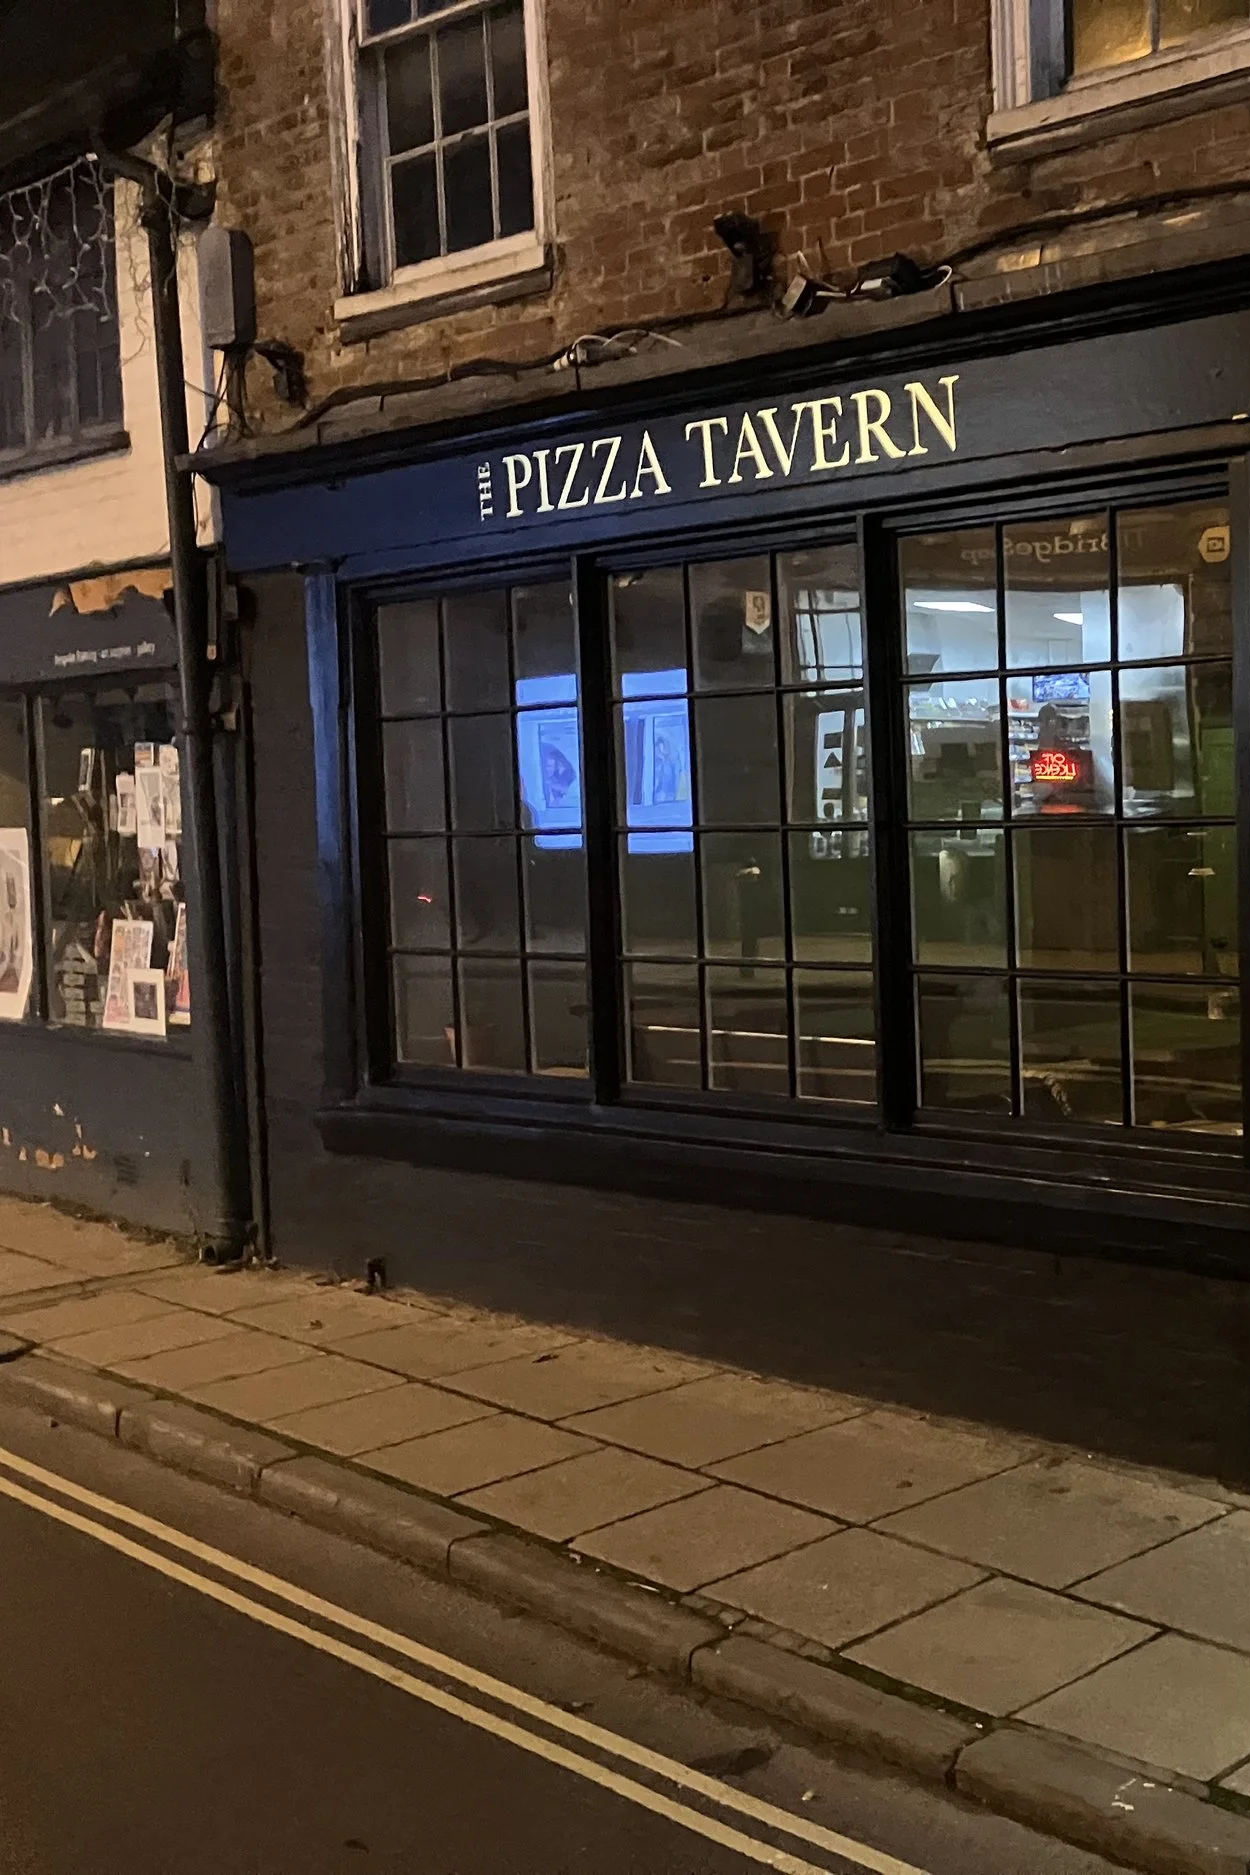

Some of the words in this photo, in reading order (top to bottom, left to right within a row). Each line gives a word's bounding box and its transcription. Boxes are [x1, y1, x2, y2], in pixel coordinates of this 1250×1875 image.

[477, 461, 492, 521] THE
[502, 430, 672, 518] PIZZA
[685, 374, 961, 489] TAVERN
